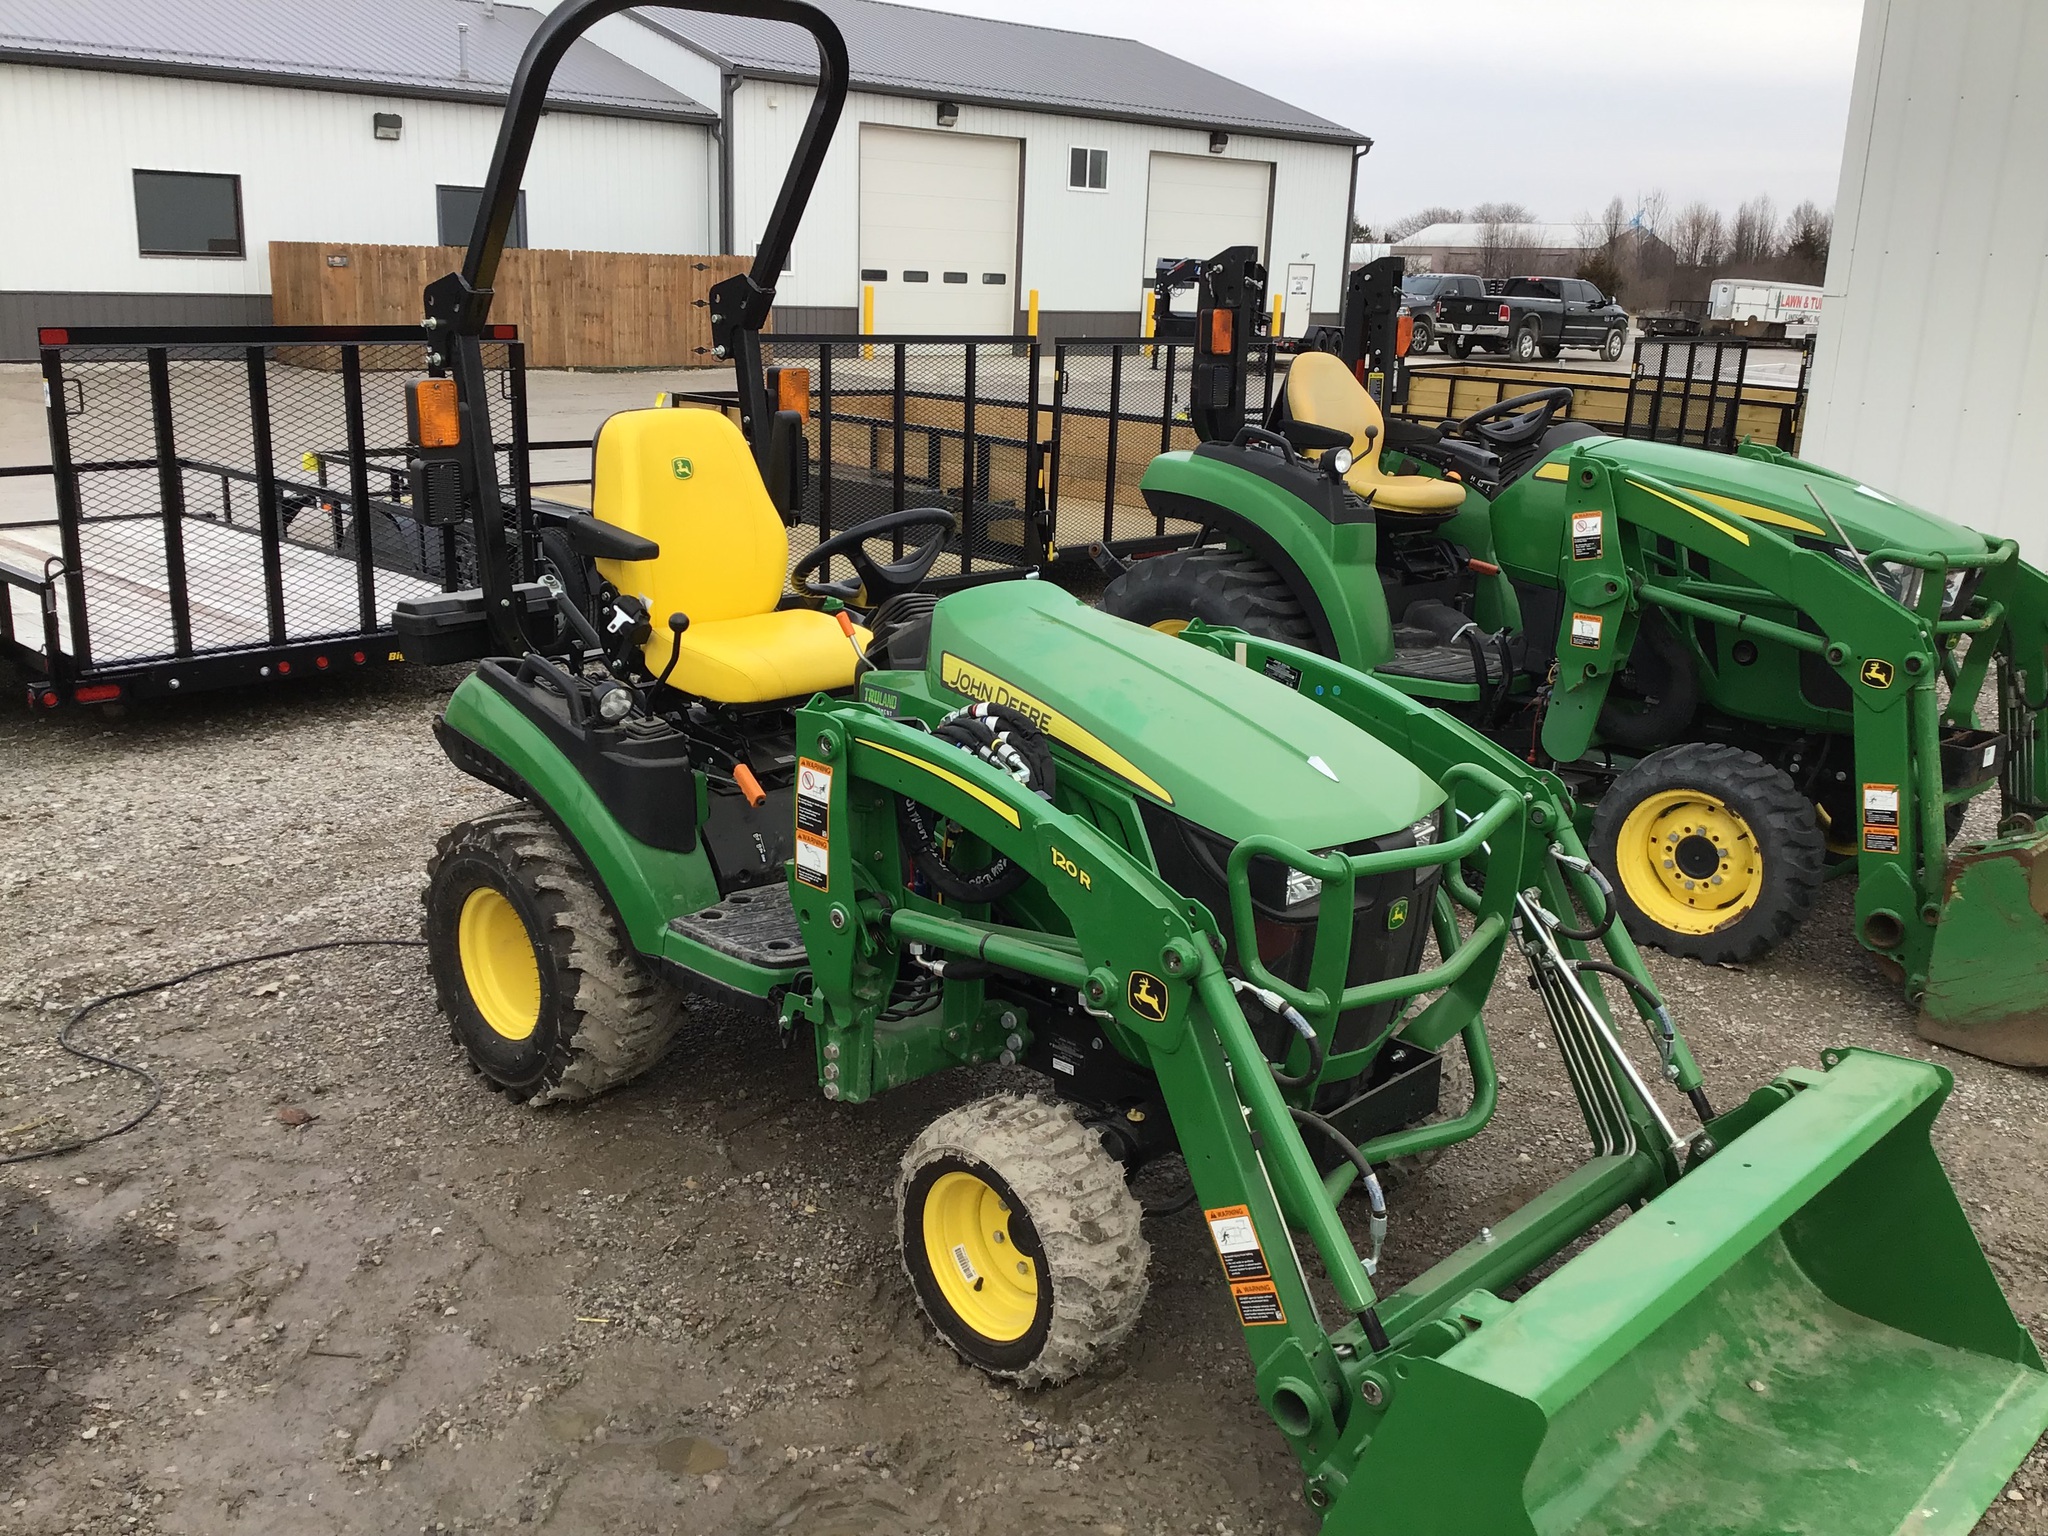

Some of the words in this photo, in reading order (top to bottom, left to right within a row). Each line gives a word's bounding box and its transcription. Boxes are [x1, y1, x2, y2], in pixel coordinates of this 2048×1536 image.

[1780, 294, 1803, 308] LAWN
[1803, 296, 1809, 309] &
[865, 688, 898, 710] TRULAND
[950, 668, 993, 702] JOHN
[996, 687, 1052, 733] DEERE
[804, 762, 831, 775] WARNING
[802, 833, 827, 849] WARNING
[1217, 1208, 1244, 1218] WARNING
[1243, 1284, 1272, 1293] WARNING
